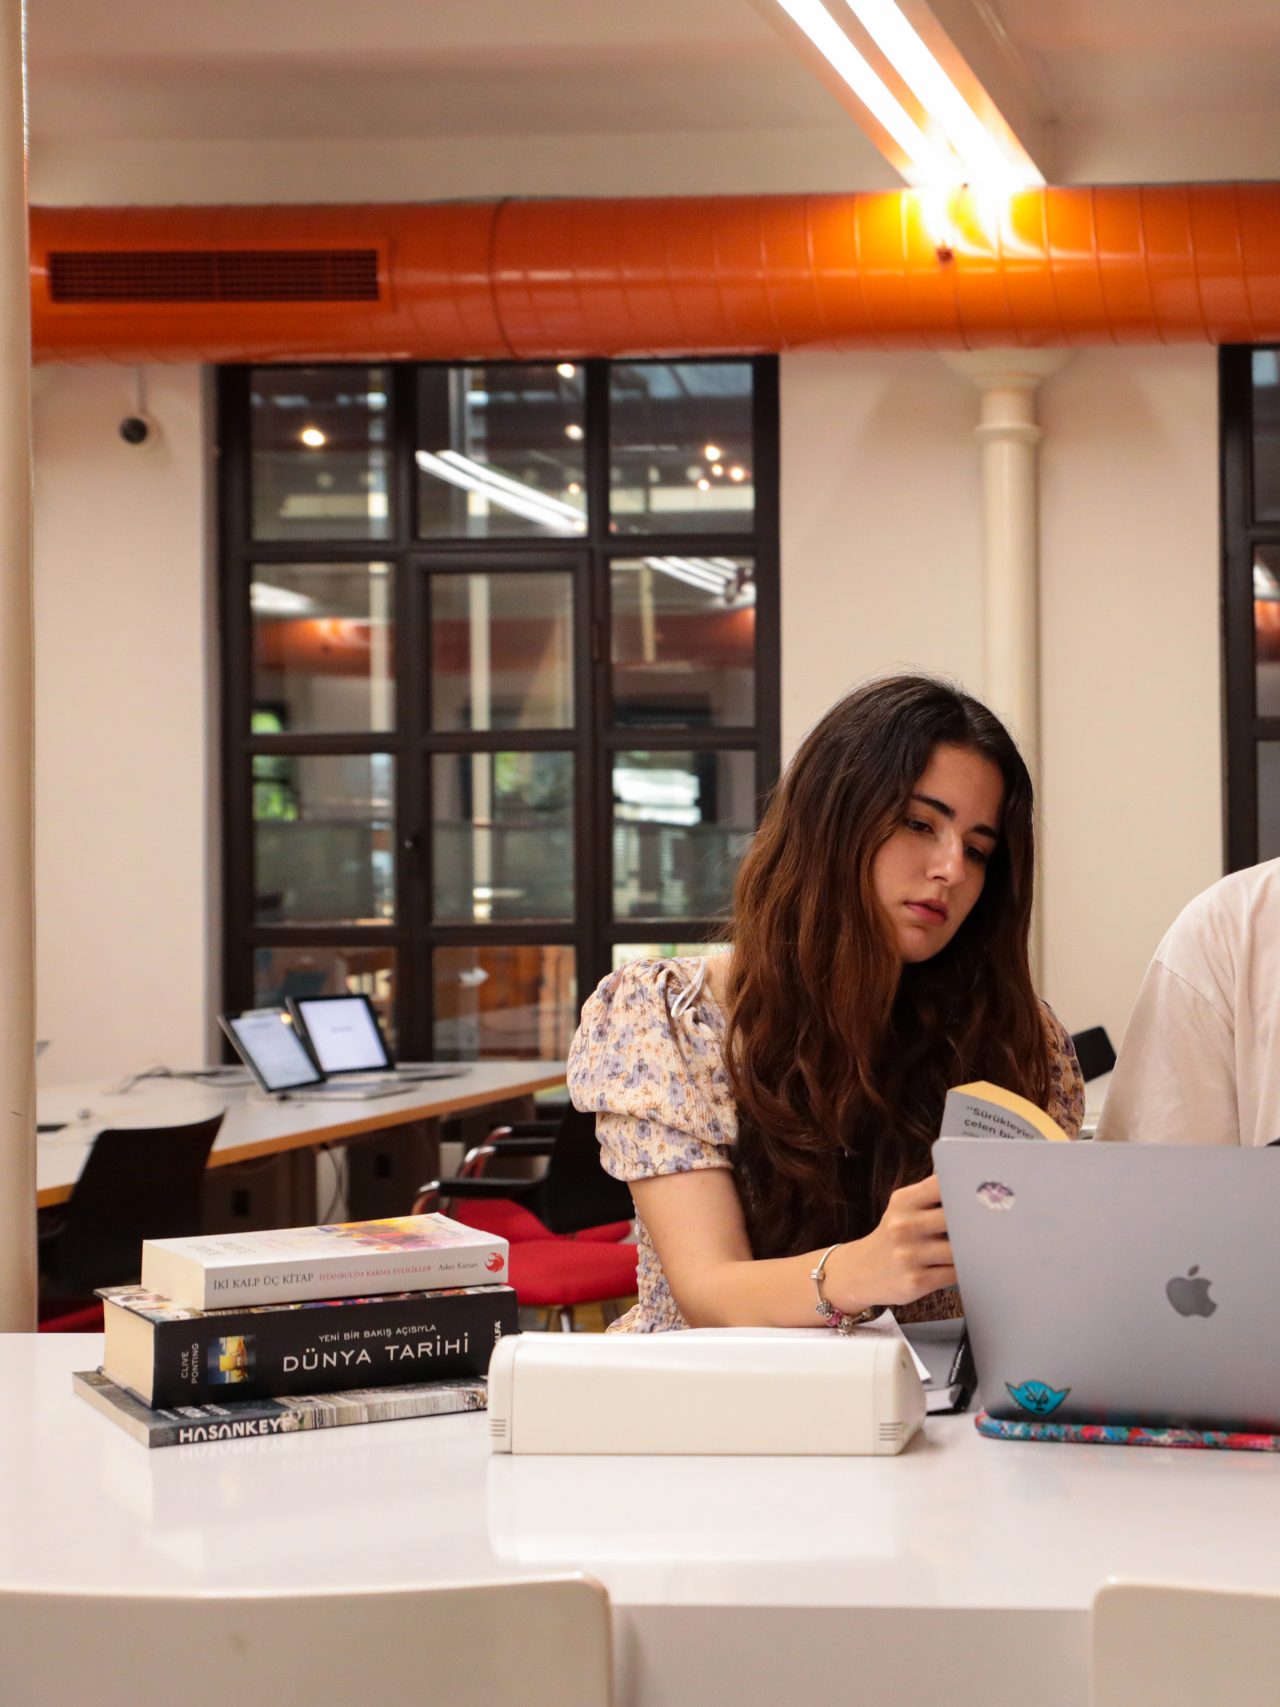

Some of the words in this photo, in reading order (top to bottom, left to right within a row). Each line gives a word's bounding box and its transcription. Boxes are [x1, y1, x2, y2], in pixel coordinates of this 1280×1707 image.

[964, 1119, 996, 1134] çelen
[213, 1279, 229, 1290] İKİ
[232, 1278, 260, 1289] KALP
[263, 1274, 280, 1287] ÜÇ
[282, 1272, 314, 1284] KİTAP
[318, 1333, 340, 1343] YENİ
[343, 1329, 360, 1341] BİR
[363, 1326, 393, 1338] BAKIŞ
[395, 1323, 437, 1336] AÇISIYLA
[191, 1342, 200, 1384] PONTING
[282, 1347, 372, 1373] DÜNYA
[384, 1332, 469, 1362] TARİHİ
[181, 1351, 189, 1379] CLIVE
